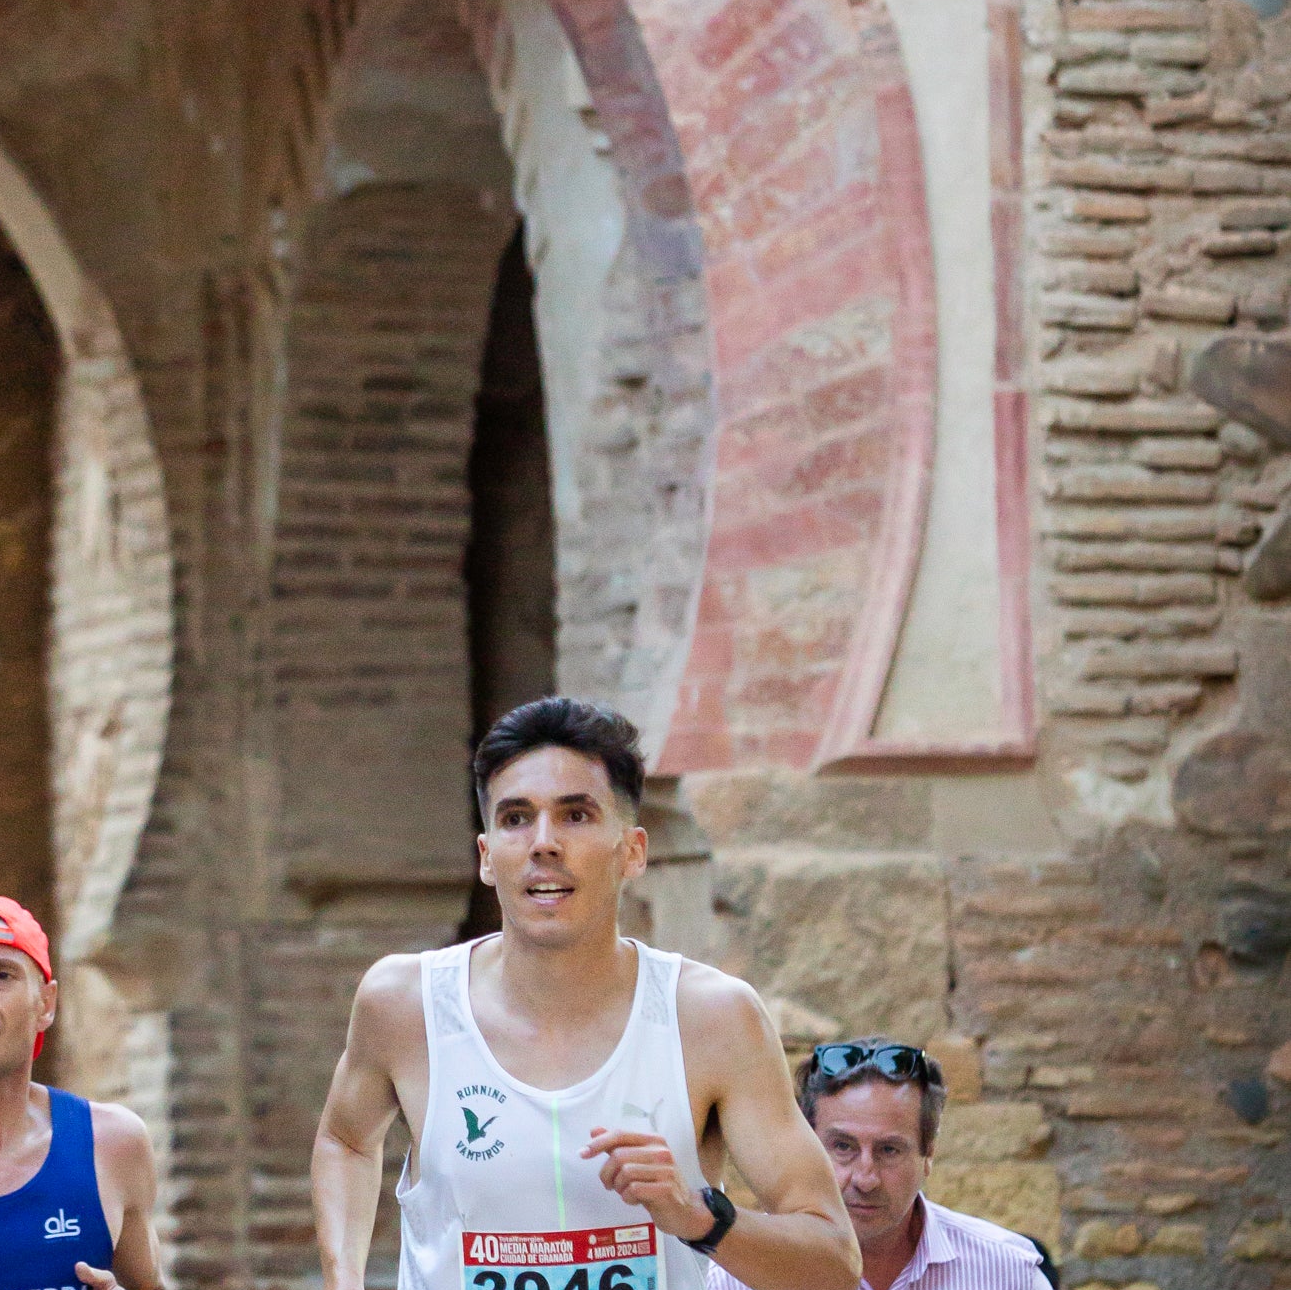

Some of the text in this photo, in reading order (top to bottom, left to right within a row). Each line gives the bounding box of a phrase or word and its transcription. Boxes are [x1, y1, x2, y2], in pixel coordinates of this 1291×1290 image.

[456, 1085, 507, 1104] RUNNING
[456, 1139, 505, 1162] VAMPIROS
[470, 1235, 500, 1263] 40
[500, 1239, 574, 1254] MEDIA MARATÓN
[587, 1248, 594, 1260] 4
[594, 1245, 616, 1259] MAYO
[617, 1243, 638, 1257] 2024
[500, 1252, 574, 1263] CIUDAD DE GRANADA
